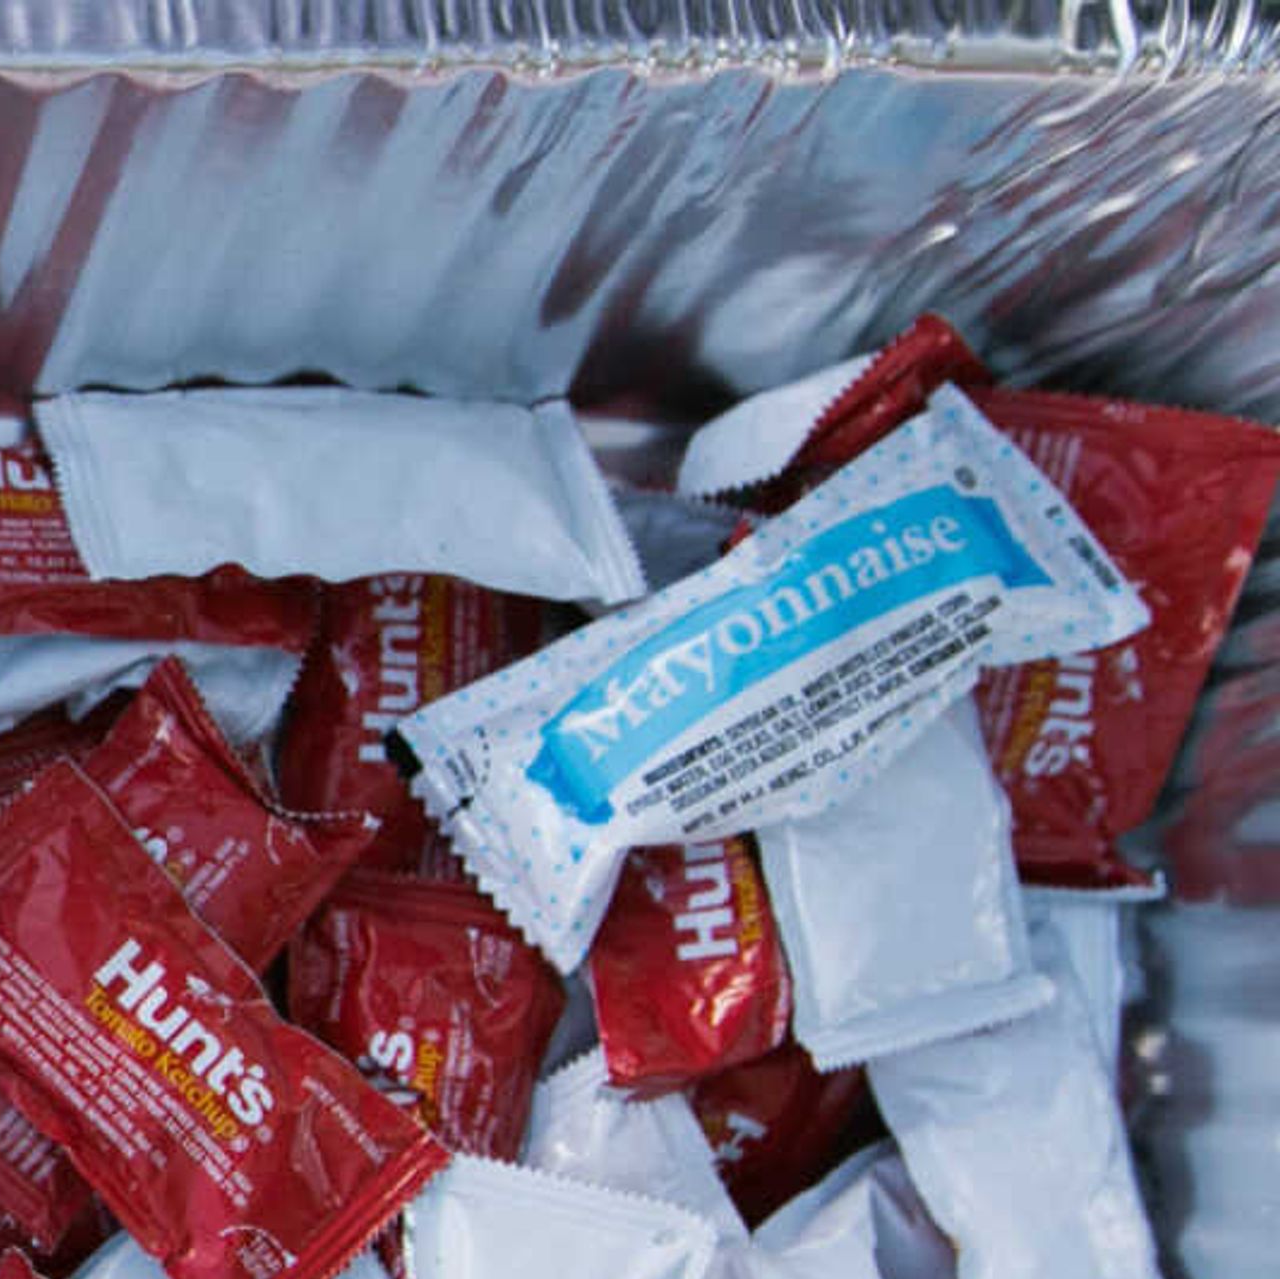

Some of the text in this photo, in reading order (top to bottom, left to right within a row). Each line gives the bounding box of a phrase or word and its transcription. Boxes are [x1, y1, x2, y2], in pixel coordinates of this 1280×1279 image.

[569, 513, 969, 752] Mayonnaise
[86, 986, 158, 1059] Tomato
[153, 1051, 241, 1141] Ketchup
[92, 937, 274, 1127] Hunt's
